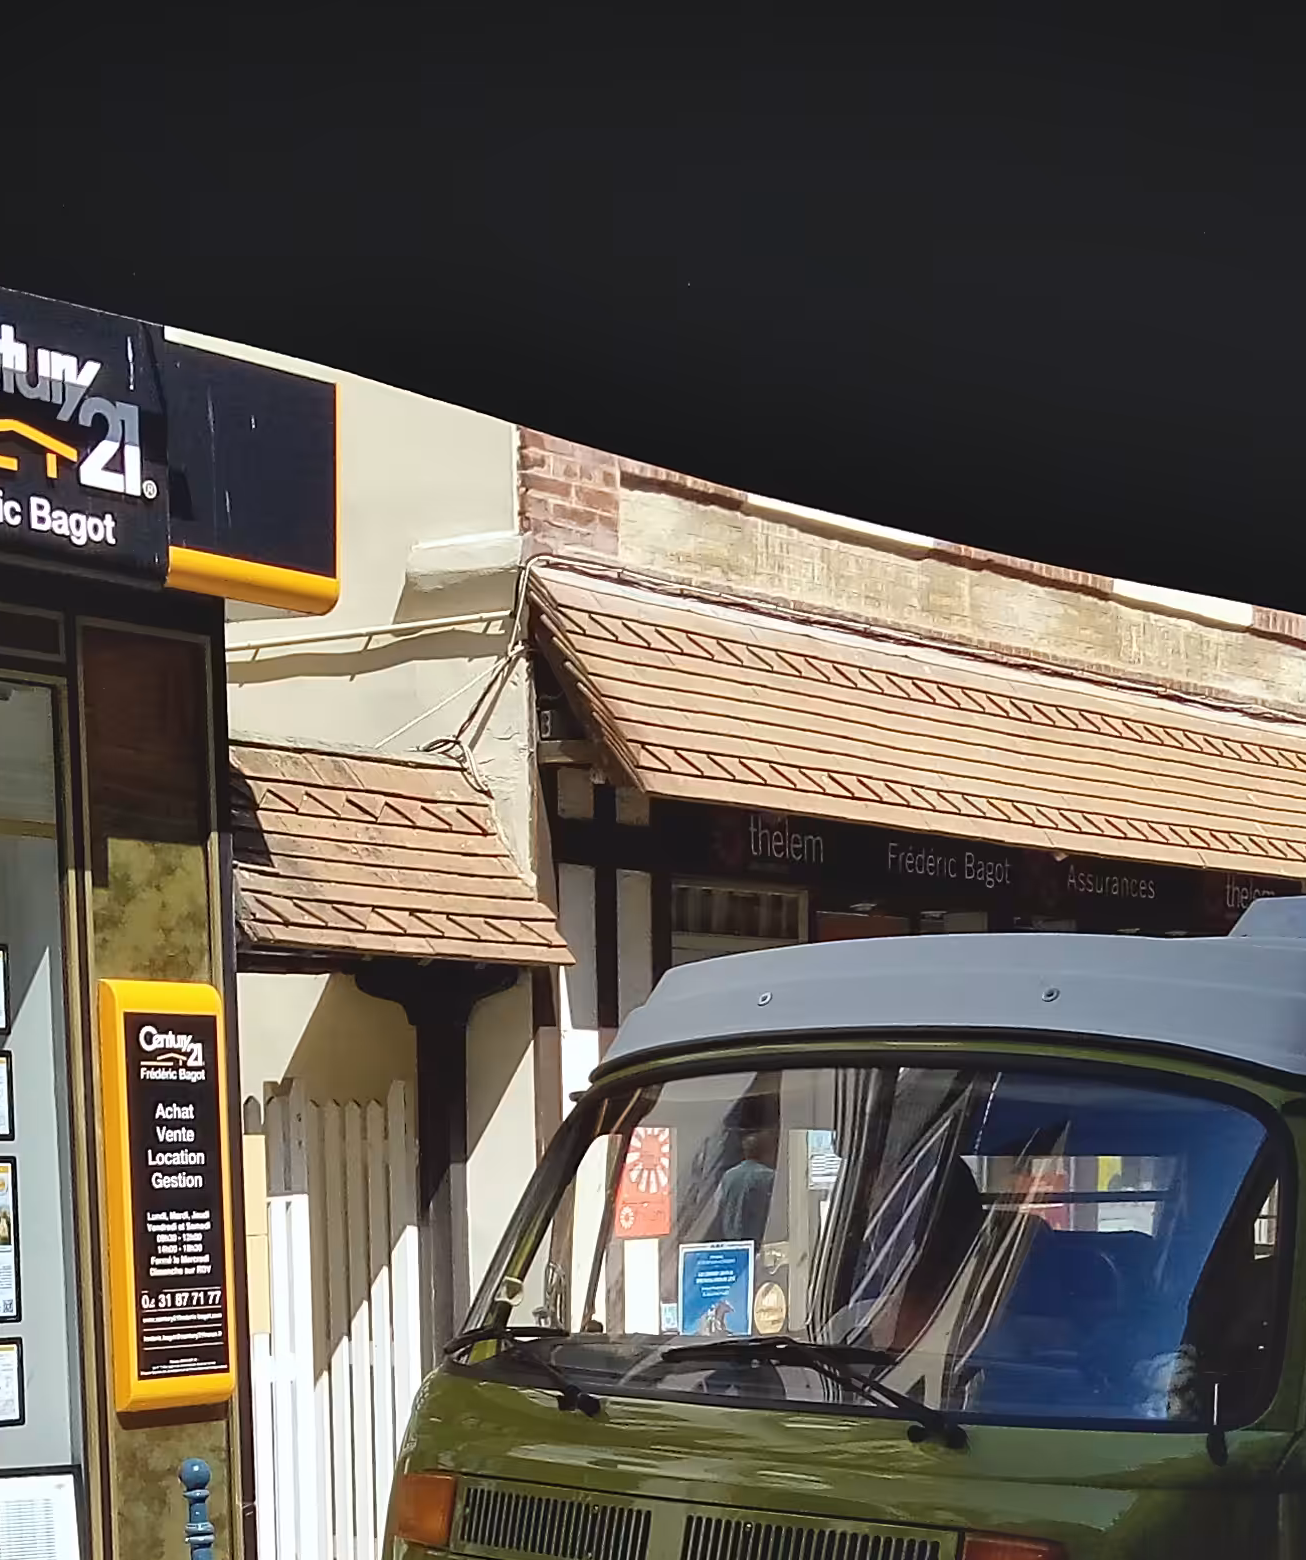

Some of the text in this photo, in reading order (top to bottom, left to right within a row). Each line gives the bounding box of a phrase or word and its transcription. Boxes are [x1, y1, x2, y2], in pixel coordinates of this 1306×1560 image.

[29, 496, 117, 546] Bagot
[888, 842, 957, 878] Frédéric
[964, 852, 1011, 888] Bagot
[1067, 864, 1155, 899] Assurances
[139, 1025, 192, 1052] Century
[140, 1067, 206, 1083] Frédéric Bagot
[155, 1103, 194, 1119] Achat
[156, 1126, 195, 1142] Vente
[147, 1149, 205, 1166] Location
[151, 1172, 203, 1189] Gestion
[158, 1294, 172, 1308] 31
[175, 1292, 190, 1307] 87
[191, 1291, 204, 1305] 71
[207, 1290, 222, 1304] 77
